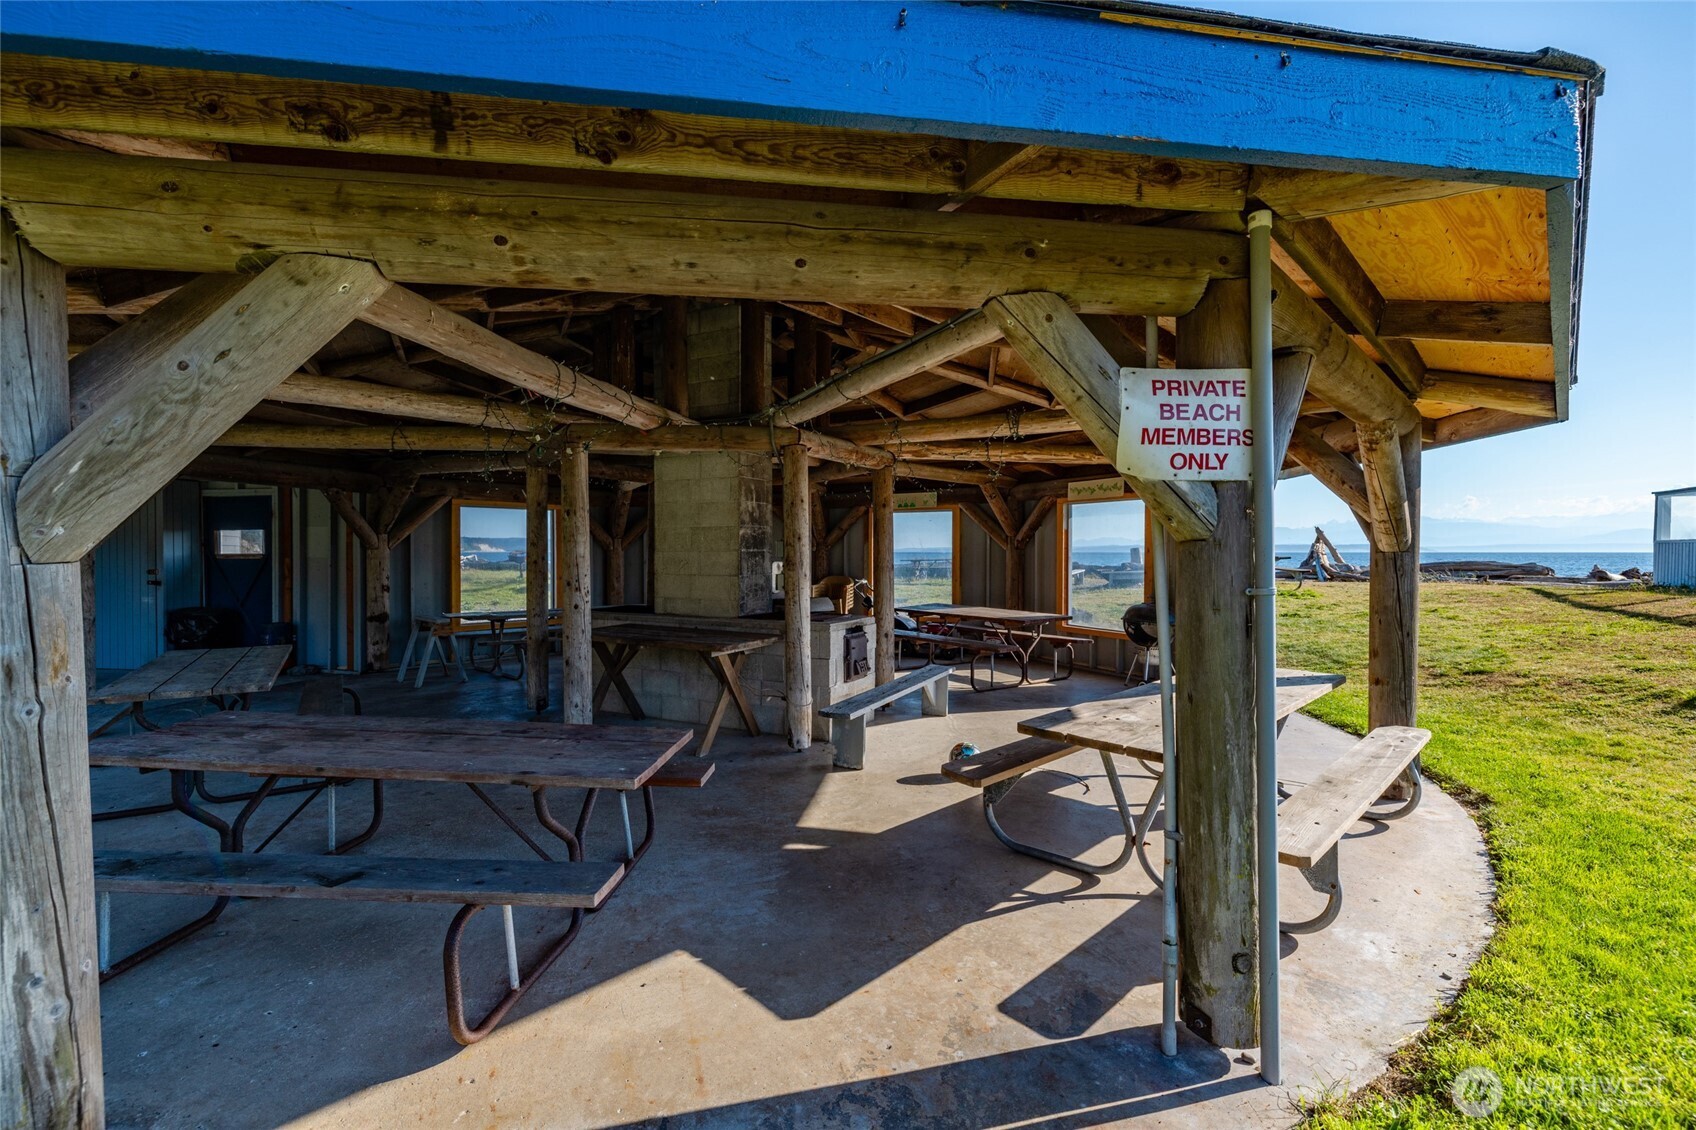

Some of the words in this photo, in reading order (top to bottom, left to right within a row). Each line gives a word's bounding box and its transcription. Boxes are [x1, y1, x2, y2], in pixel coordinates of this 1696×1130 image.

[1151, 379, 1246, 397] PRIVATE
[1159, 403, 1241, 421] BEACH
[1140, 428, 1254, 446] MEMBERS
[1169, 452, 1229, 470] ONLY
